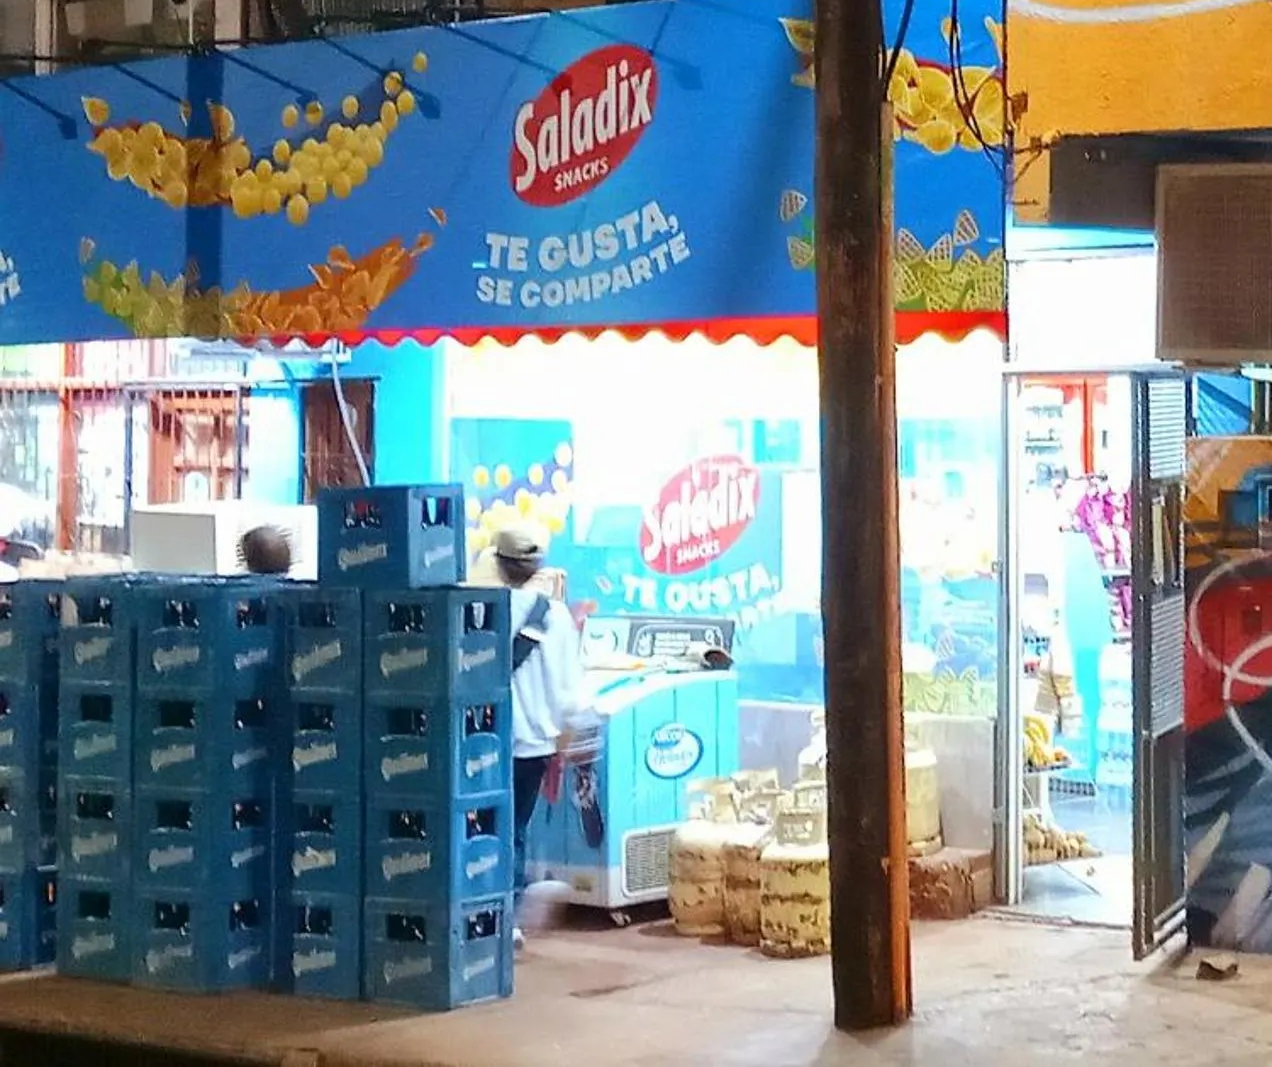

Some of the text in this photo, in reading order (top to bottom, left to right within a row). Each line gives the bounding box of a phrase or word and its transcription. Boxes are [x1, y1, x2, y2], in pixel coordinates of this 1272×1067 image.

[514, 59, 653, 192] Saladix
[554, 156, 610, 192] SNACKS
[477, 232, 691, 309] SE COMPARTE
[486, 200, 680, 272] TE GUSTA,
[642, 463, 759, 562] Saladix
